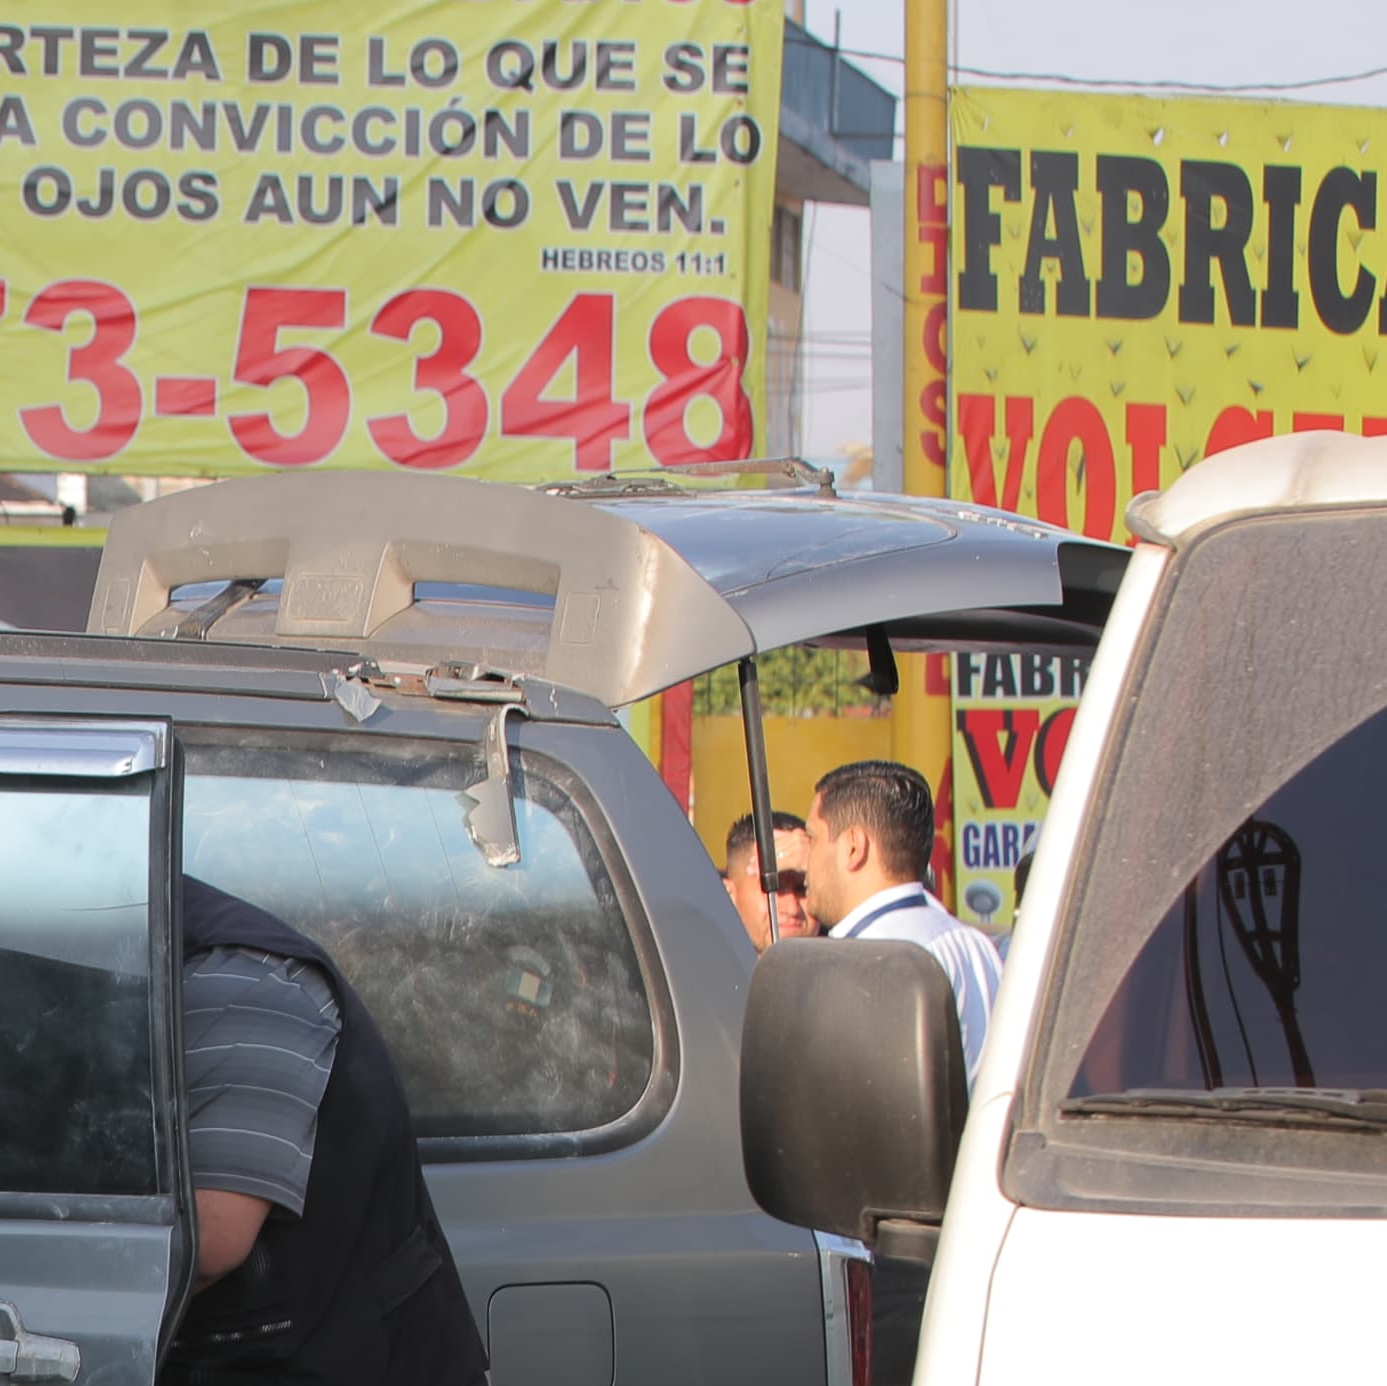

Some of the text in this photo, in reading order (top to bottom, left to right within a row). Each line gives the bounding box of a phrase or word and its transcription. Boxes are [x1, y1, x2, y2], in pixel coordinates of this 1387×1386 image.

[247, 34, 340, 85] DE
[368, 38, 459, 88] LO
[486, 40, 636, 93] QUE
[662, 43, 749, 94] SE
[62, 97, 529, 160] CONVICCIÓN
[559, 111, 651, 162] DE
[678, 114, 761, 166] LO
[22, 167, 220, 222] OJOS
[244, 174, 399, 226] AUN
[428, 178, 530, 229] NO
[556, 181, 726, 235] VEN.
[540, 248, 727, 276] HEBREOS 11:1
[956, 145, 1387, 336] FABRIC
[962, 821, 1040, 869] GAR
